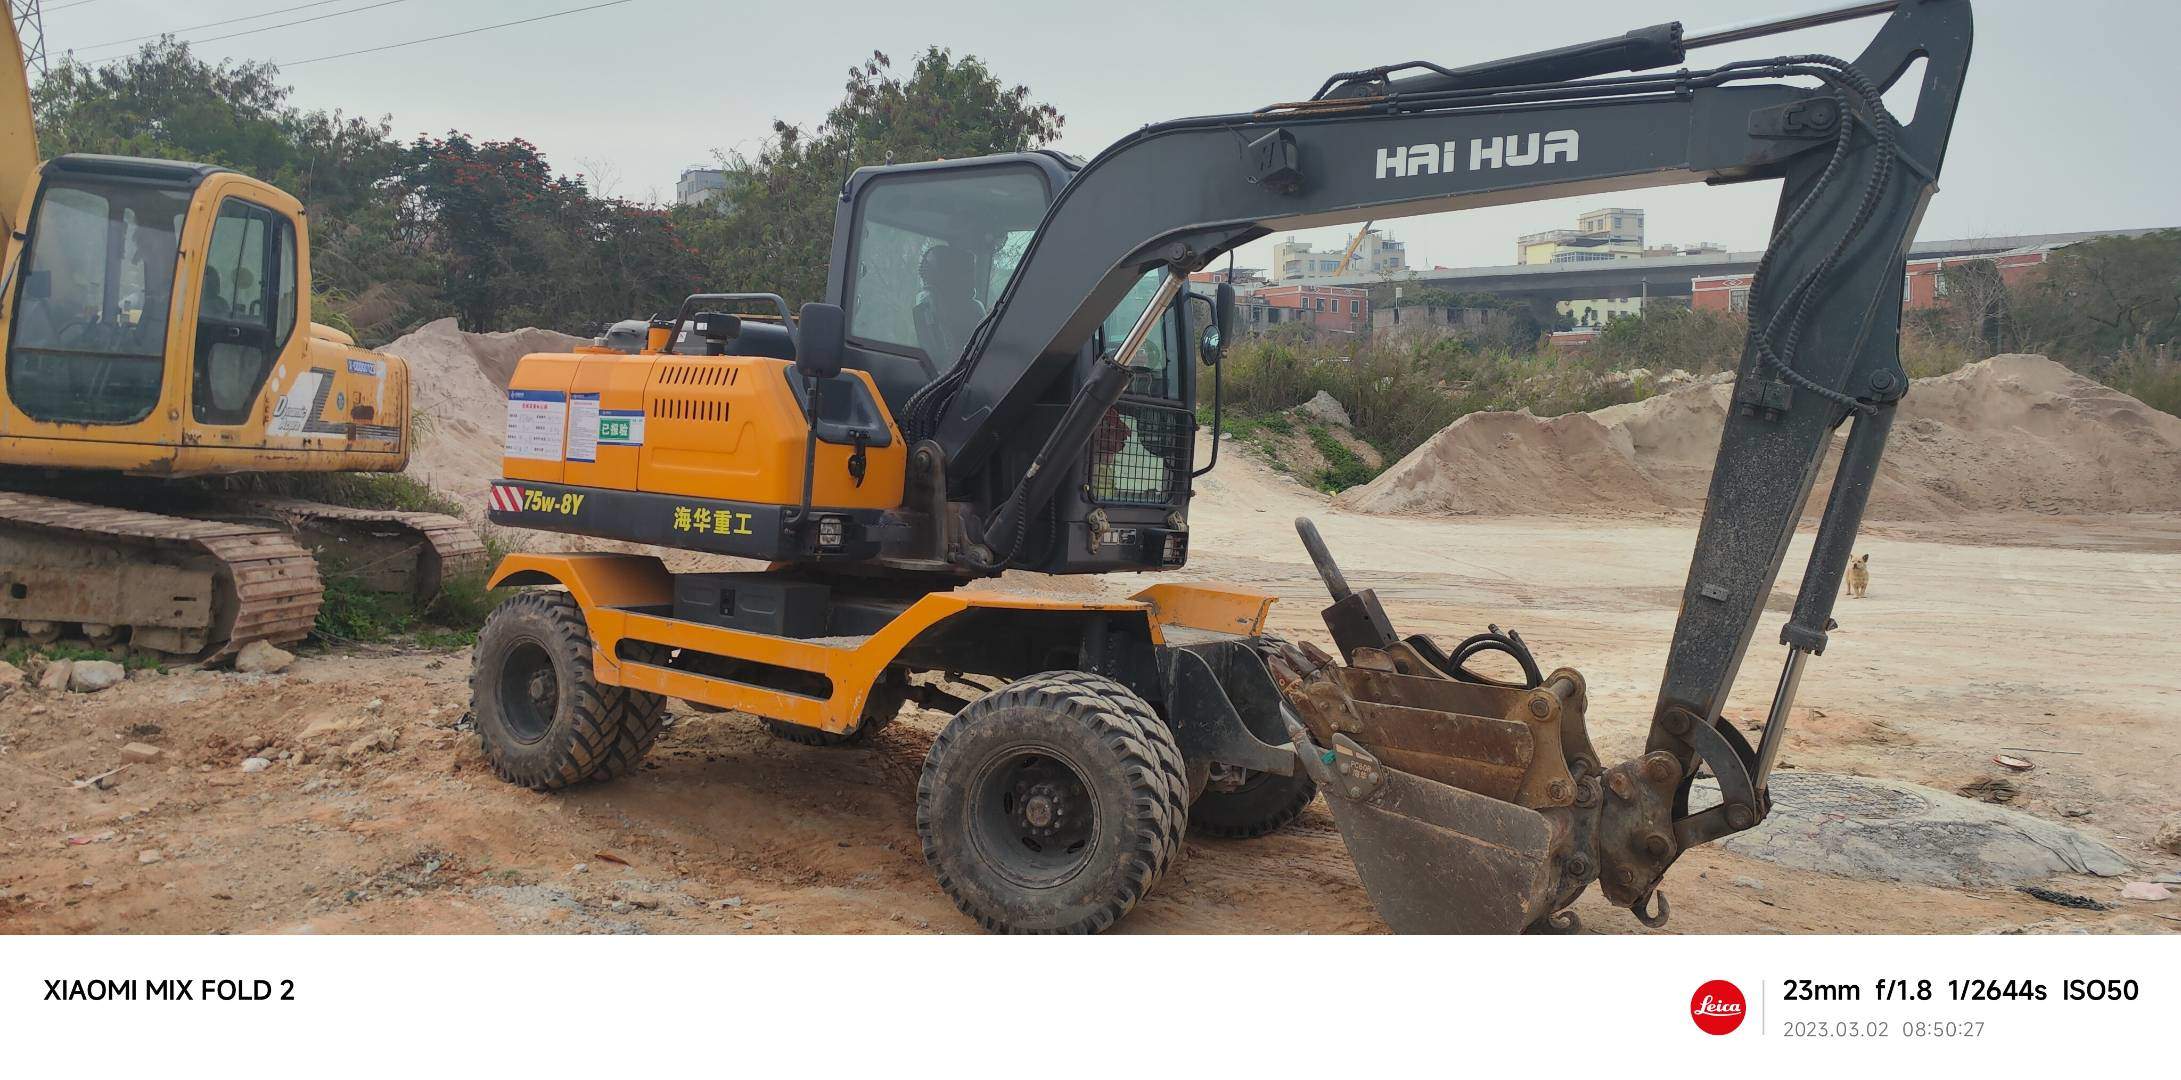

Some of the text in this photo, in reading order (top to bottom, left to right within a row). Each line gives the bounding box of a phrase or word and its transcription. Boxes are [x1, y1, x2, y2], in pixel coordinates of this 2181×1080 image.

[1469, 129, 1580, 171] HUA
[674, 505, 753, 535] 海华重工
